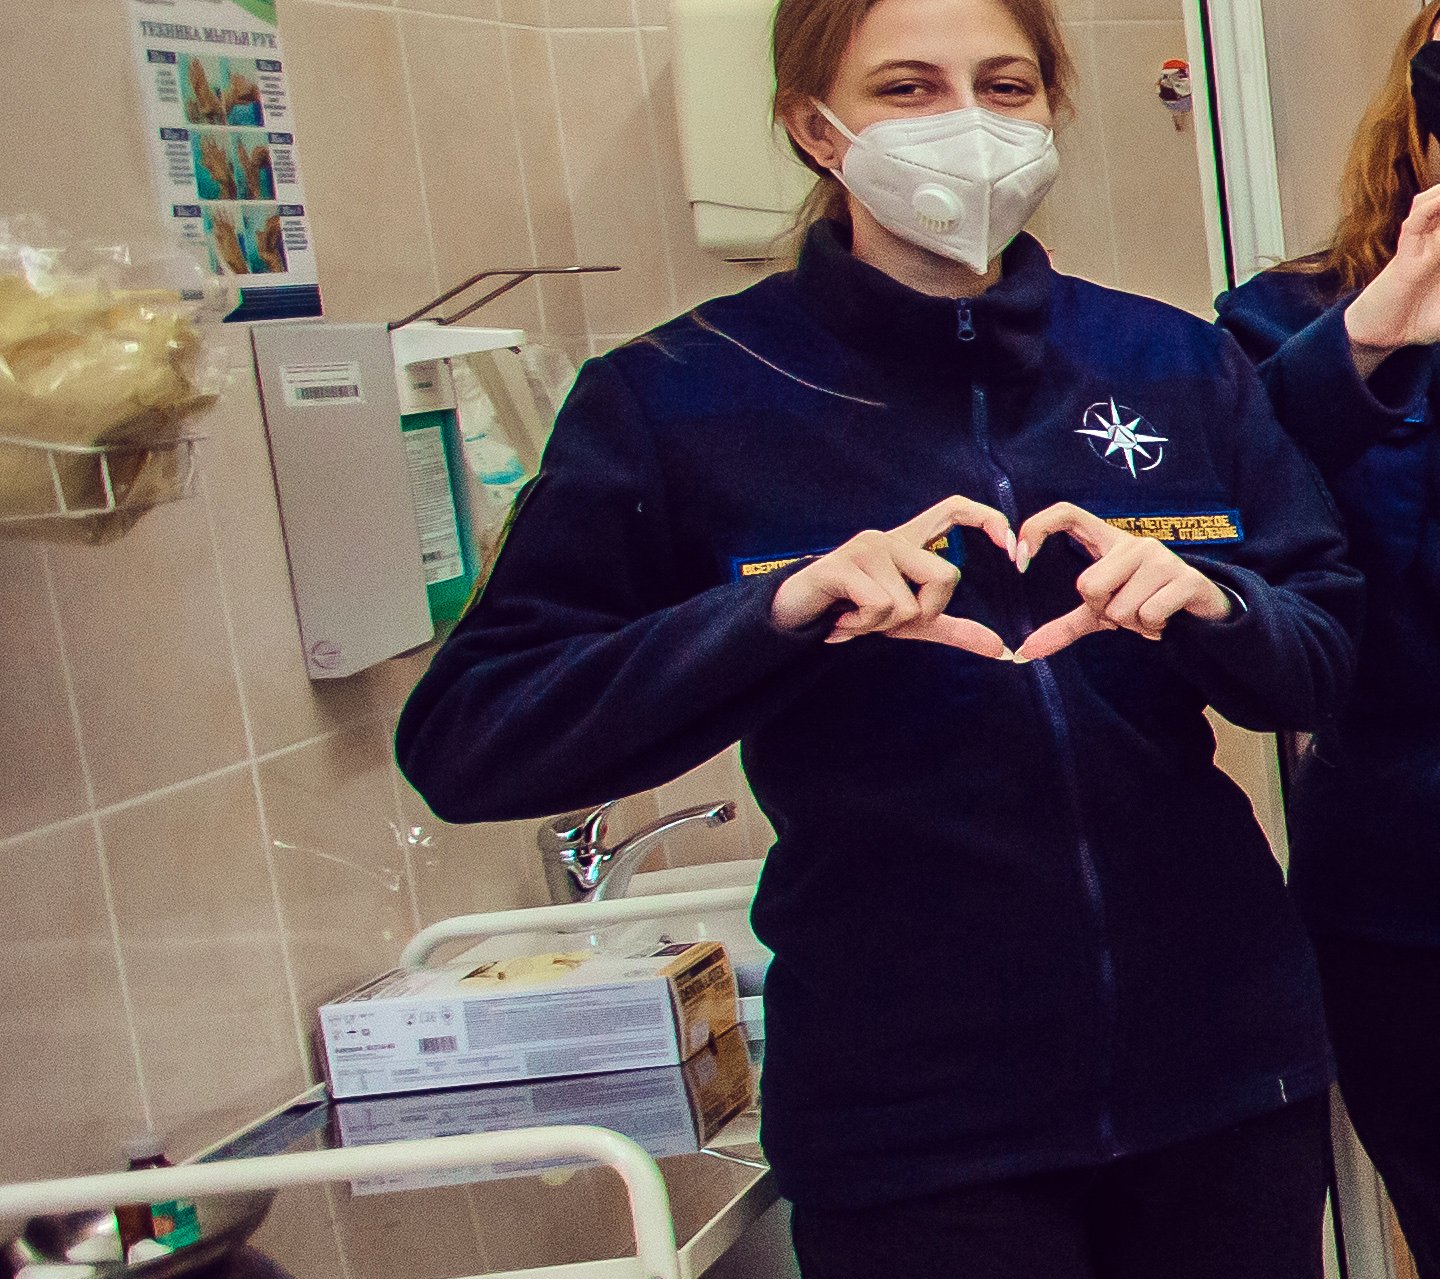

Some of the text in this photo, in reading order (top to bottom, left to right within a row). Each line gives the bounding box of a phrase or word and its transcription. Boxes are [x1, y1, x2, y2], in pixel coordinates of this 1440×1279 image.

[140, 20, 278, 49] ТЕХНИКА МЫТЬЯ РУК
